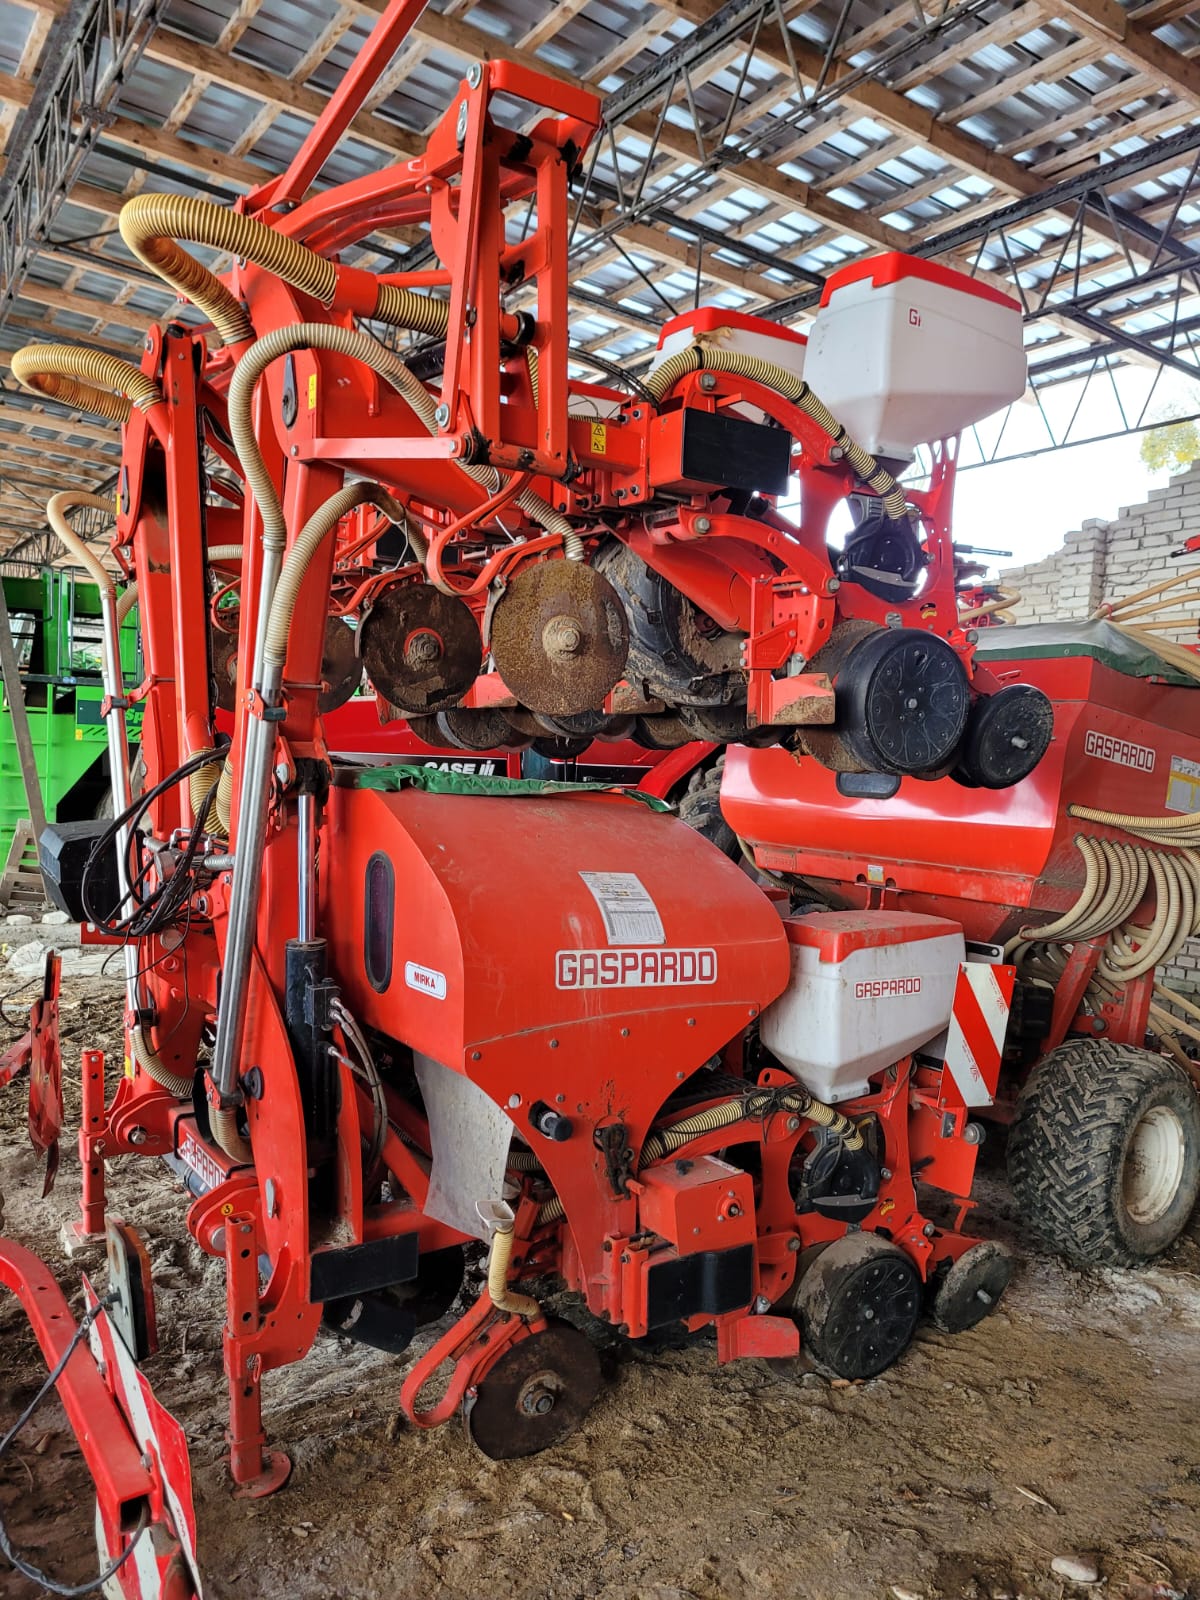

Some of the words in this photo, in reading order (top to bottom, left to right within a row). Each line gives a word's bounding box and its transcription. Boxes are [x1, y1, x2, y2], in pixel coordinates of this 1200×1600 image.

[1085, 732, 1154, 771] GASPARDO
[558, 951, 715, 986] GASPARDO
[855, 978, 921, 998] GASPARDO
